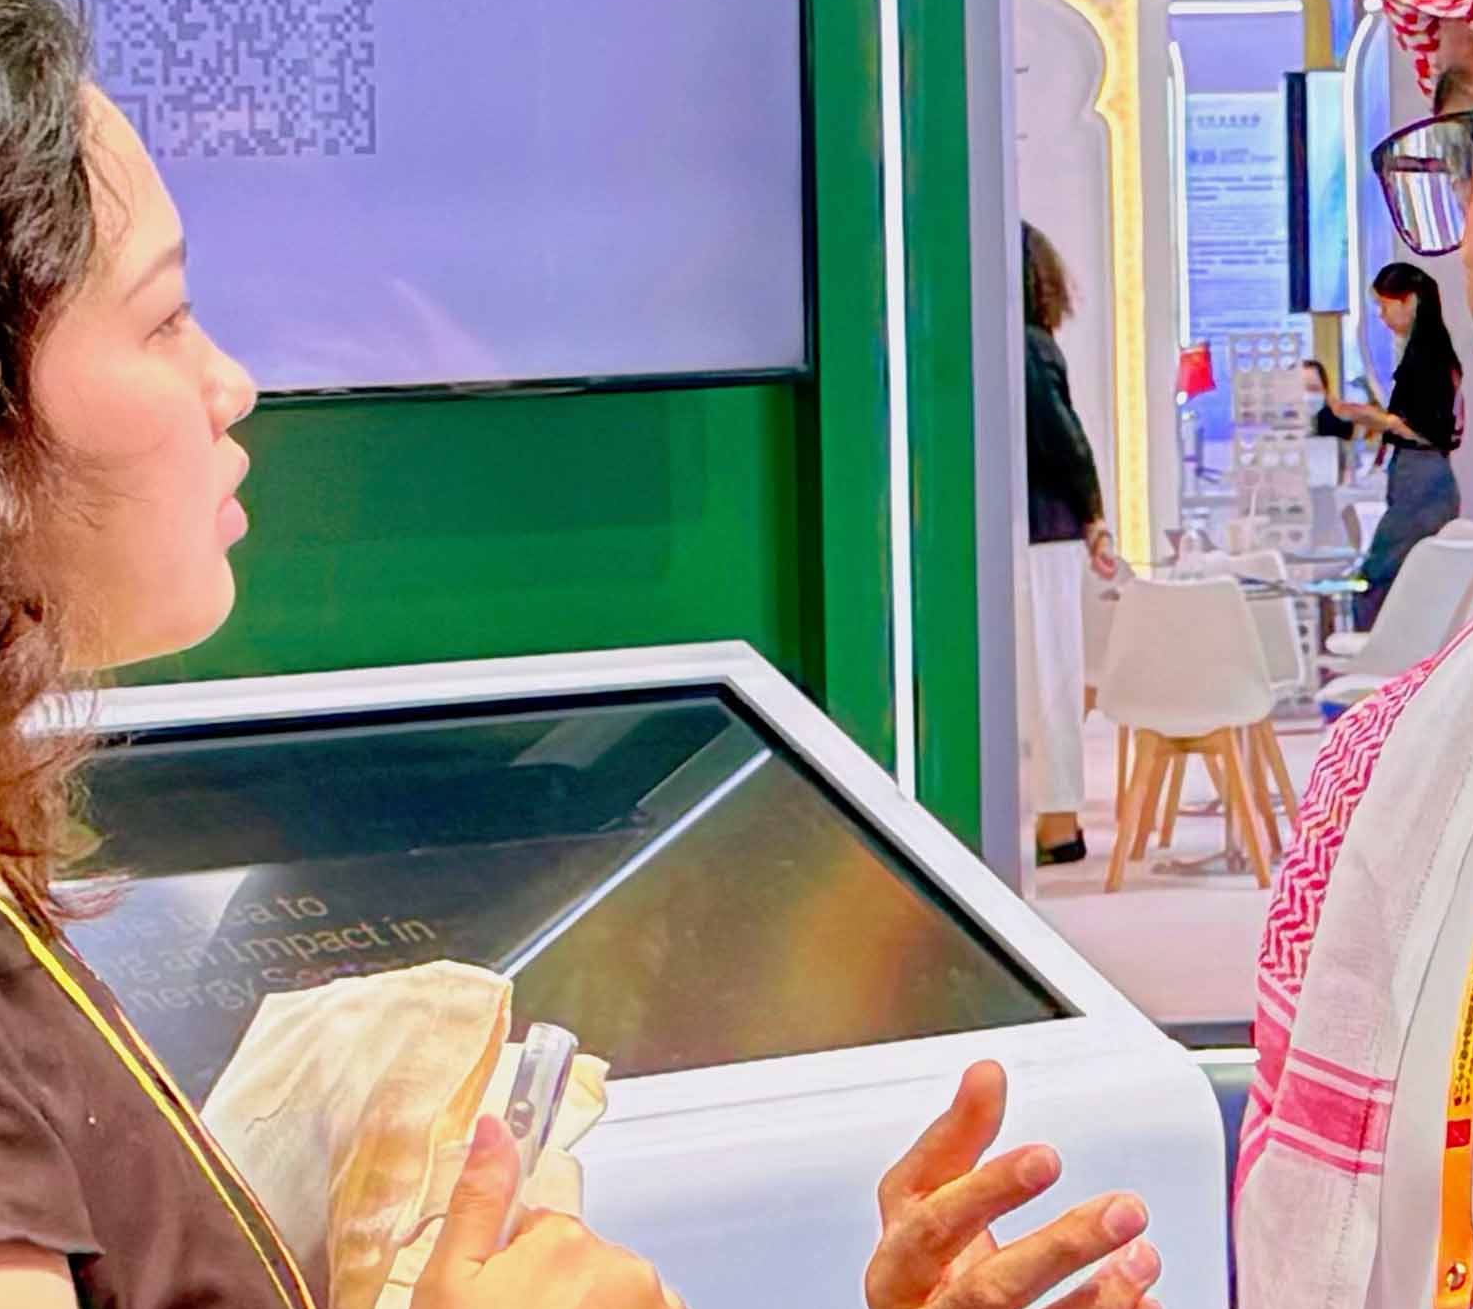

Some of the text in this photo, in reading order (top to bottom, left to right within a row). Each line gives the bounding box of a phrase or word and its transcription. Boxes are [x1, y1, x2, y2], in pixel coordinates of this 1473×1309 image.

[276, 893, 328, 920] to
[158, 939, 220, 973] an
[223, 920, 388, 963] Impact
[379, 914, 437, 944] in
